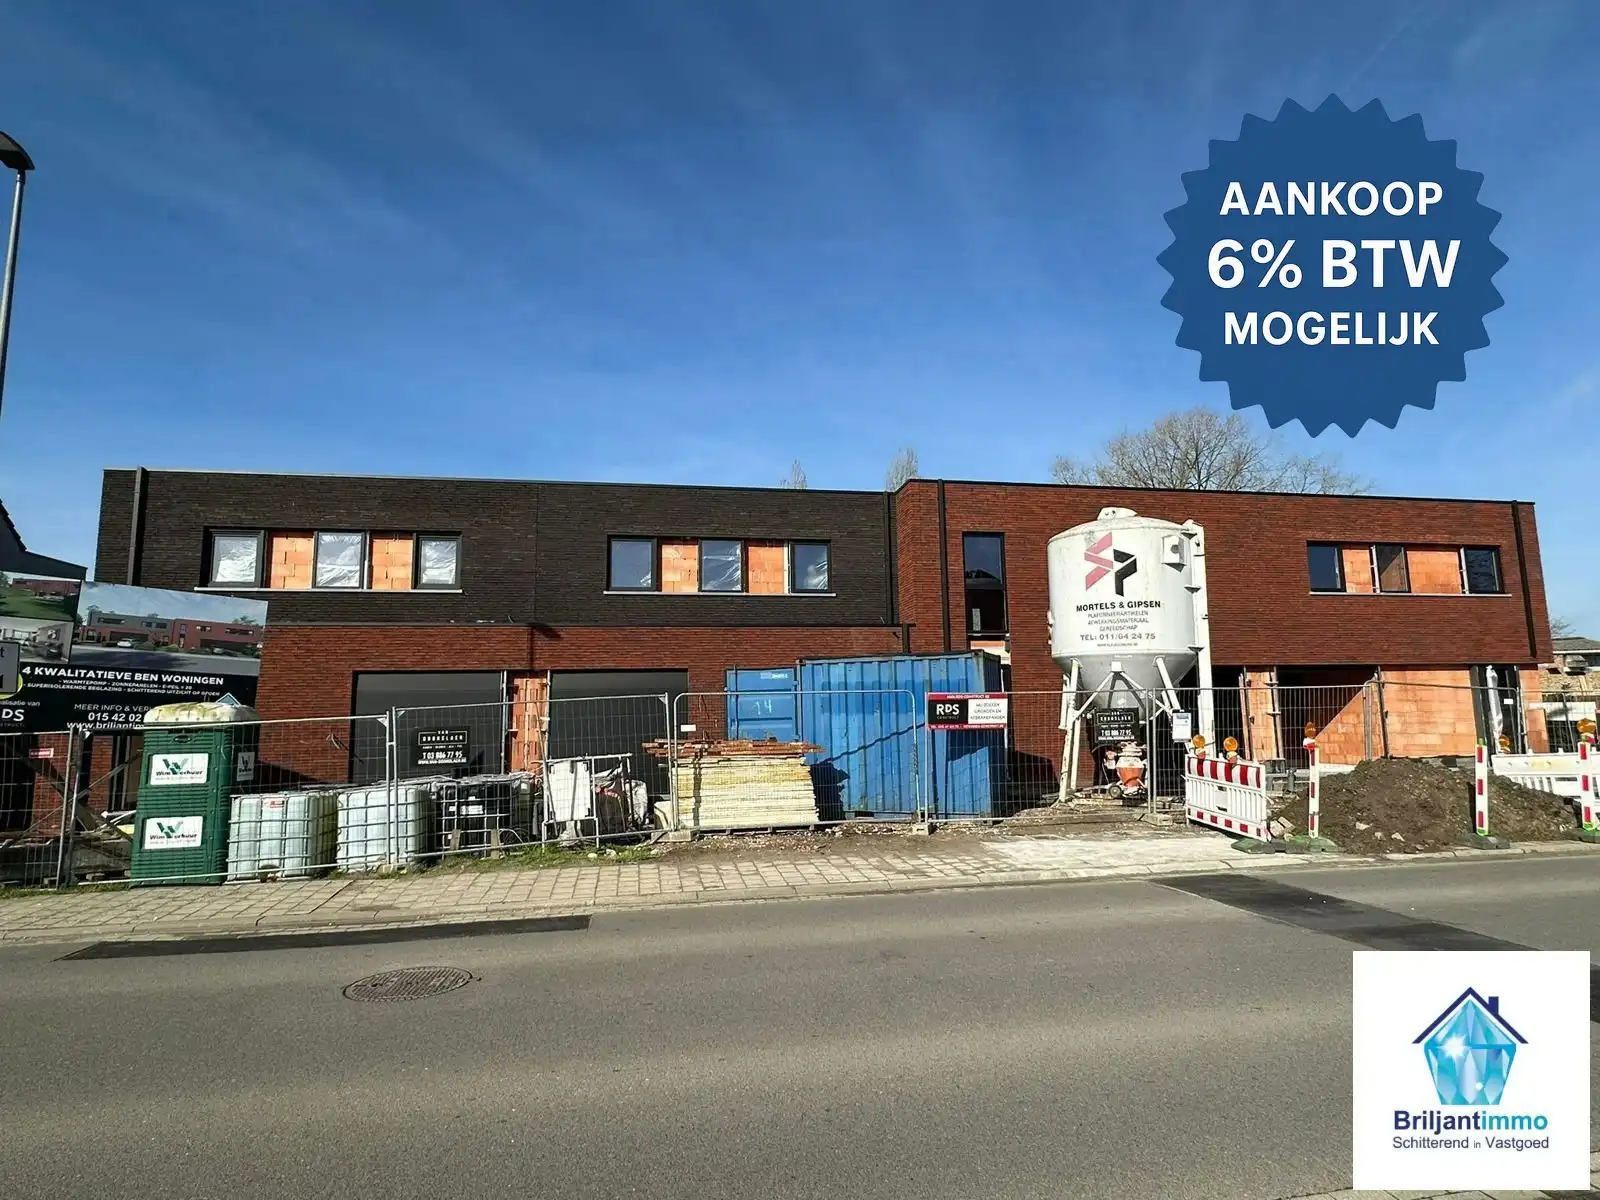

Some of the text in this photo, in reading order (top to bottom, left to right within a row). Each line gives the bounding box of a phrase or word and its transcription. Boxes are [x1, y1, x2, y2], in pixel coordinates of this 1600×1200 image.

[1076, 601, 1116, 612] MORTELS
[1127, 600, 1161, 608] GIPSEN
[22, 666, 224, 685] 4 KWALITATIEVE BEN WONINGEN
[2, 709, 24, 721] DS
[936, 703, 960, 715] RDS
[88, 712, 142, 722] 015 42 02
